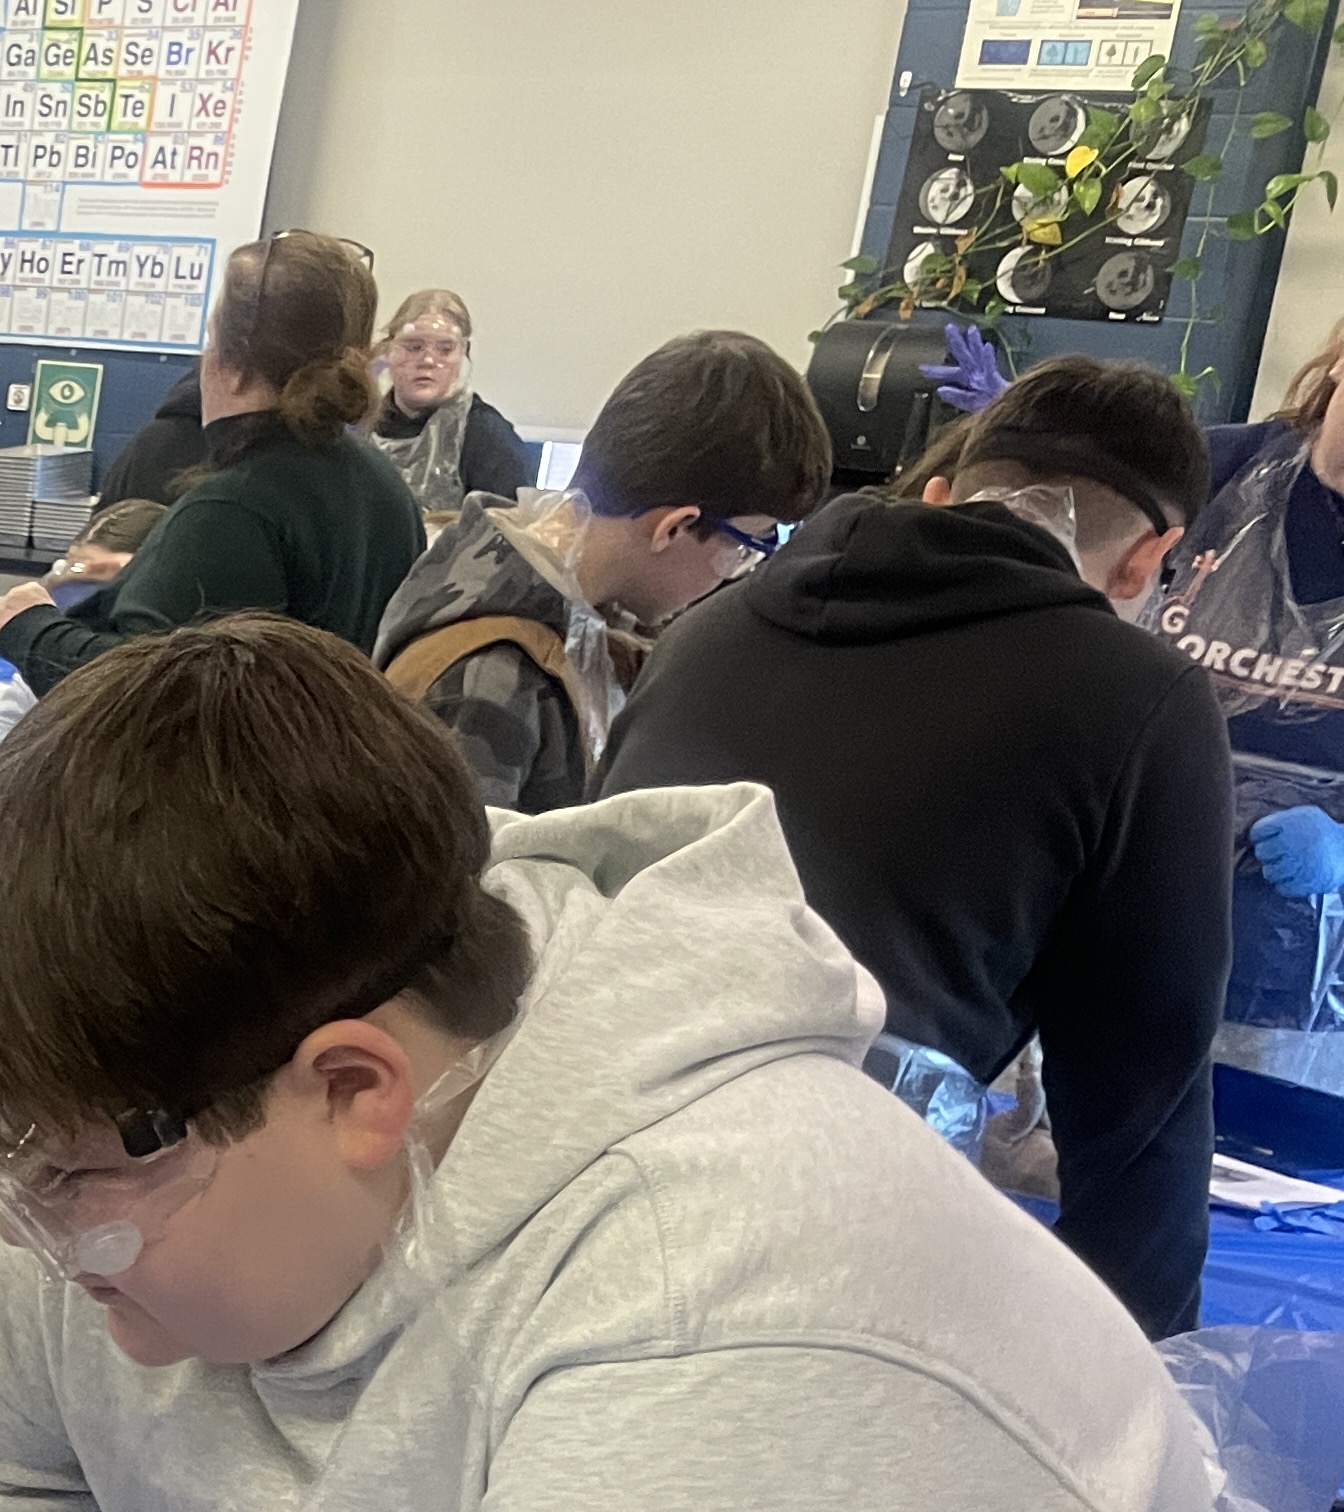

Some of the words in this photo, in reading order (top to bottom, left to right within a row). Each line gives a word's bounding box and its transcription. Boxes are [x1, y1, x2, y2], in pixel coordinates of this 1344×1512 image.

[6, 43, 35, 66] Ga
[44, 42, 75, 66] Ge
[82, 42, 114, 66] As
[123, 41, 153, 66] Se
[166, 41, 194, 65] Br
[205, 40, 235, 64] Kr
[4, 93, 24, 117] In
[38, 93, 67, 117] Sn
[76, 93, 107, 117] Sb
[118, 93, 144, 117] Te
[168, 93, 175, 117] I
[195, 92, 226, 117] Xe
[0, 144, 19, 167] Tl
[32, 144, 61, 167] Pb
[73, 144, 97, 168] Bi
[109, 145, 138, 168] Po
[150, 145, 177, 169] At
[186, 145, 218, 169] Rn
[19, 250, 49, 273] Ho
[60, 252, 84, 274] Er
[92, 252, 127, 276] Tm
[135, 254, 164, 278] Yb
[174, 255, 203, 280] Lu
